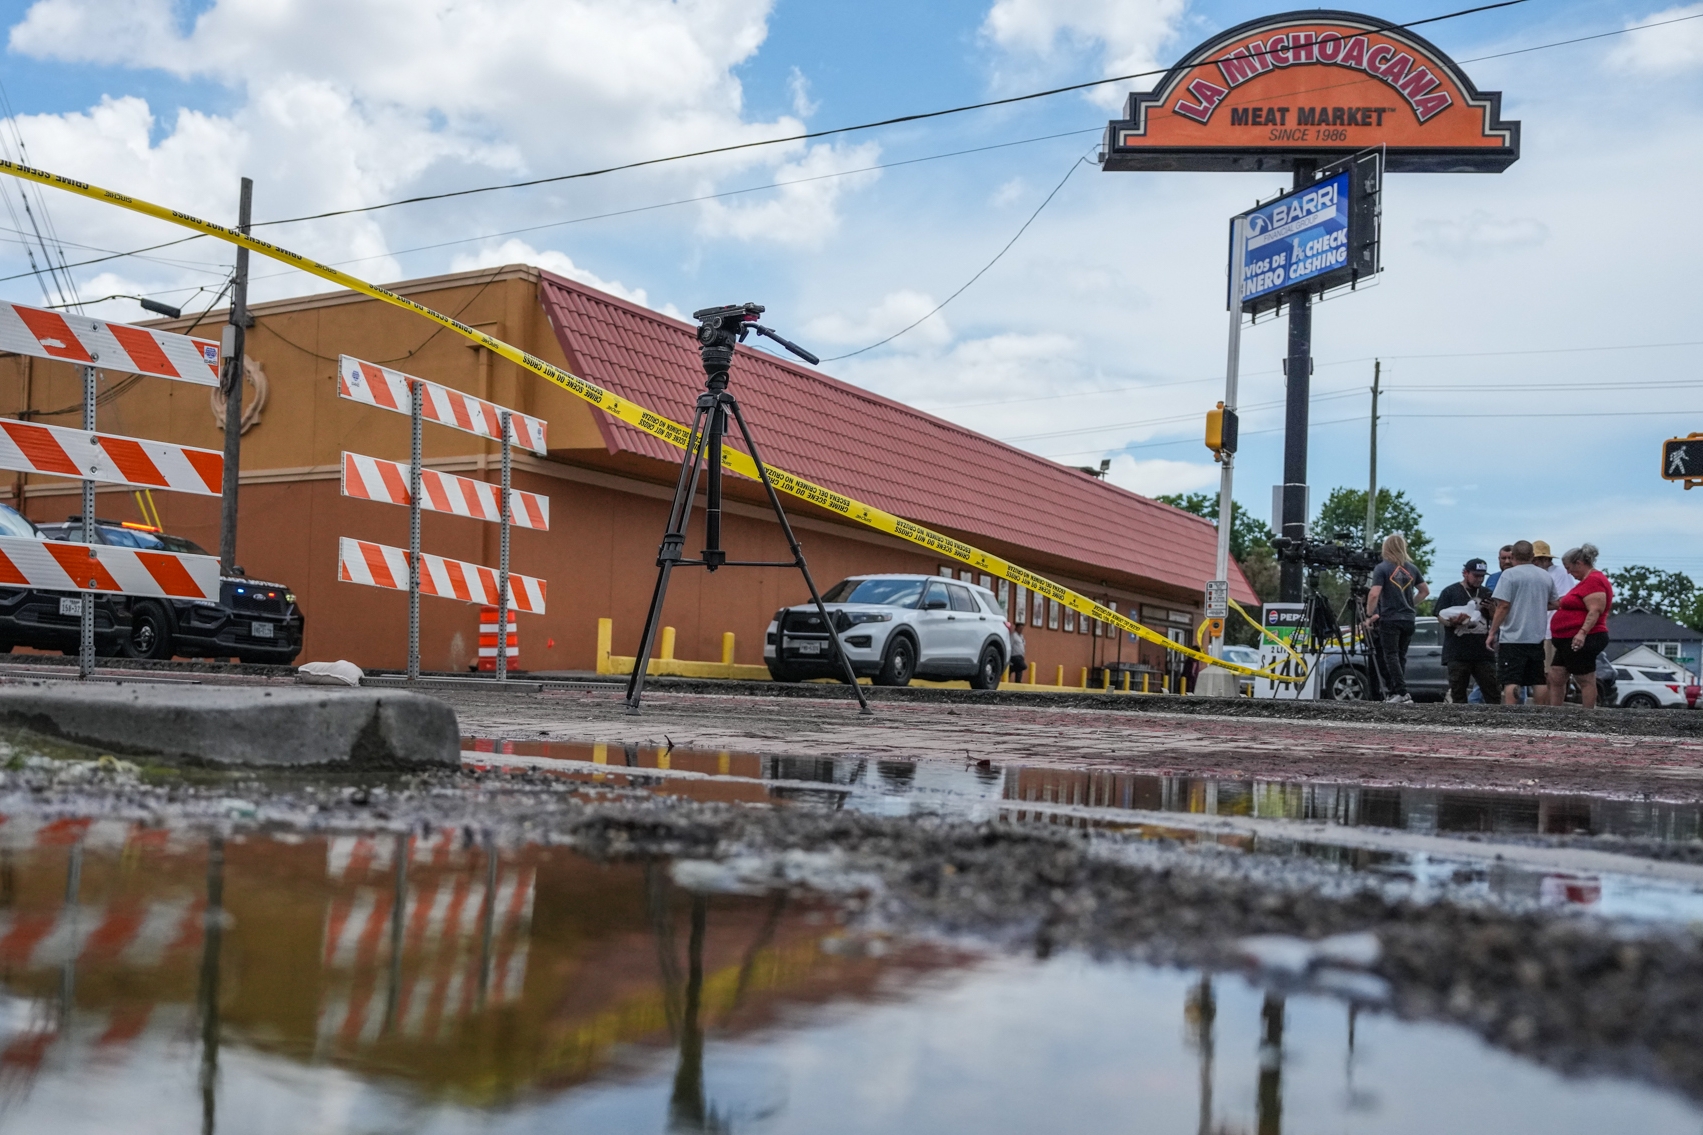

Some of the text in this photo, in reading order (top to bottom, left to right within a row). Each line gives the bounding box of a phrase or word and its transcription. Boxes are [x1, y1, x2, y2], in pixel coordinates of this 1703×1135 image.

[1174, 32, 1452, 124] LA MICHOACANA
[1230, 107, 1289, 126] MEAT
[1268, 128, 1348, 142] SINCE 1986
[1273, 182, 1338, 228] BARRI
[1263, 215, 1318, 242] FINANCIAL GROUP
[1305, 228, 1348, 257] CHECK
[1272, 252, 1287, 268] DE
[1290, 247, 1347, 279] CASHING
[1243, 268, 1284, 296] INERO
[522, 355, 542, 371] CROSS
[543, 365, 556, 378] NOT
[557, 373, 565, 384] DO
[565, 379, 585, 394] SCENE
[584, 389, 602, 404] CRIME
[638, 419, 654, 430] CROSS
[642, 412, 689, 438] DEL CRIMEN NO CRUZAR
[654, 426, 665, 436] NOT
[672, 435, 686, 447] SCENE
[764, 467, 850, 507] ESCENA DEL CRIMEN NO CRUZA
[781, 481, 794, 492] NOT
[795, 488, 805, 496] DO
[807, 493, 827, 505] SCENE
[828, 501, 849, 513] CRIME
[894, 526, 913, 538] CROSS
[896, 520, 916, 532] CRUZAR
[914, 534, 926, 543] NOT
[926, 531, 944, 543] CRIMEN
[936, 542, 953, 553] SCENE
[953, 542, 971, 554] ESCENA
[953, 549, 970, 560] CRIME
[1006, 571, 1020, 581] CROSS
[1008, 564, 1023, 576] CRUZAR
[1038, 585, 1051, 596] SCENE
[1052, 591, 1065, 601] CRIME
